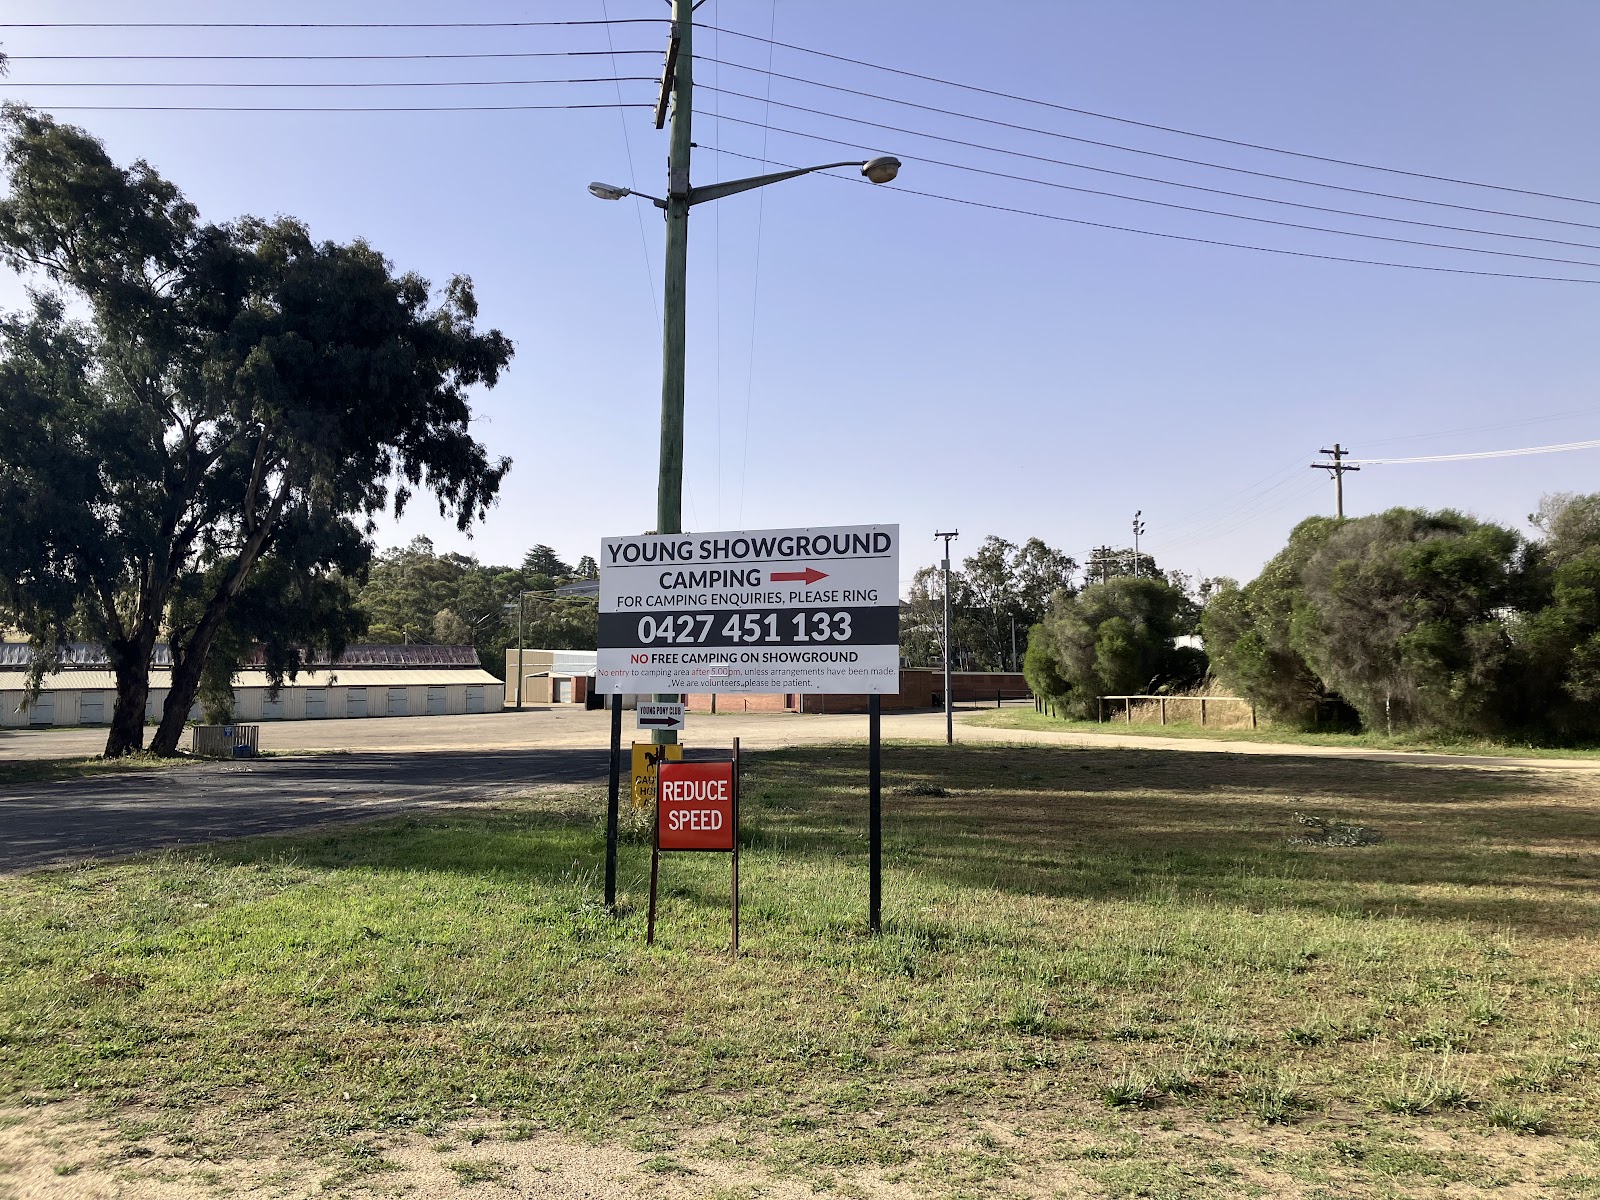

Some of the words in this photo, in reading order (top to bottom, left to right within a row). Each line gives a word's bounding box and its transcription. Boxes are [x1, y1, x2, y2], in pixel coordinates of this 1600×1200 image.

[608, 541, 693, 563] YOUNG
[699, 532, 891, 559] SHOWGROUND
[659, 569, 761, 590] CAMPING
[617, 596, 643, 608] FOR
[645, 595, 707, 607] CAMPING
[711, 592, 785, 606] ENQUIRIES,
[789, 590, 840, 603] PLEASE
[843, 589, 878, 602] RING
[637, 614, 715, 644] 0427
[721, 613, 781, 642] 451
[791, 611, 852, 641] 133
[630, 654, 649, 665] NO
[651, 653, 679, 664] FREE
[681, 652, 738, 664] CAMPING
[740, 652, 760, 663] ON
[762, 651, 859, 663] SHOWGROUND
[598, 669, 609, 677] No
[610, 669, 629, 678] entry
[631, 668, 639, 676] to
[641, 667, 672, 678] camping
[691, 667, 709, 676] after
[744, 667, 769, 676] unless
[770, 666, 825, 677] arrangements
[826, 666, 846, 676] have
[848, 666, 869, 676] been
[870, 666, 896, 676] made.
[671, 679, 685, 687] We
[744, 678, 769, 688] please
[771, 678, 781, 687] be
[783, 678, 813, 688] patient.
[640, 706, 656, 715] YOUNG
[656, 706, 668, 715] PONY
[669, 707, 682, 716] CLUB
[662, 780, 728, 802] REDUCE
[668, 809, 723, 831] SPEED
